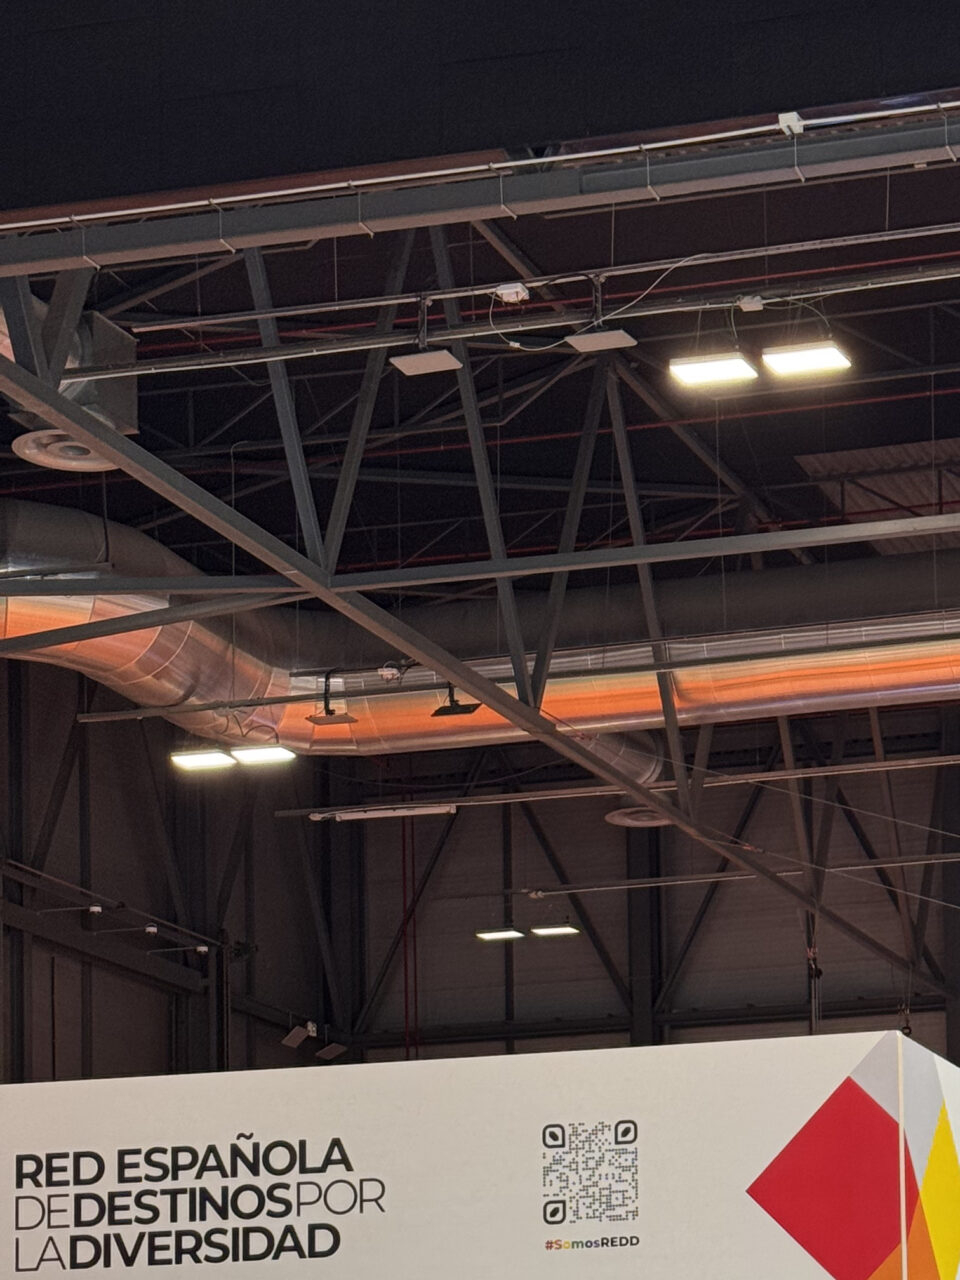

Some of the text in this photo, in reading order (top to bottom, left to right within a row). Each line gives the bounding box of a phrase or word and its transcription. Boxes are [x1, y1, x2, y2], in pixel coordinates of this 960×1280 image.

[15, 1132, 354, 1189] RED ESPAÑOLA
[545, 1236, 640, 1250] #SomosREDD
